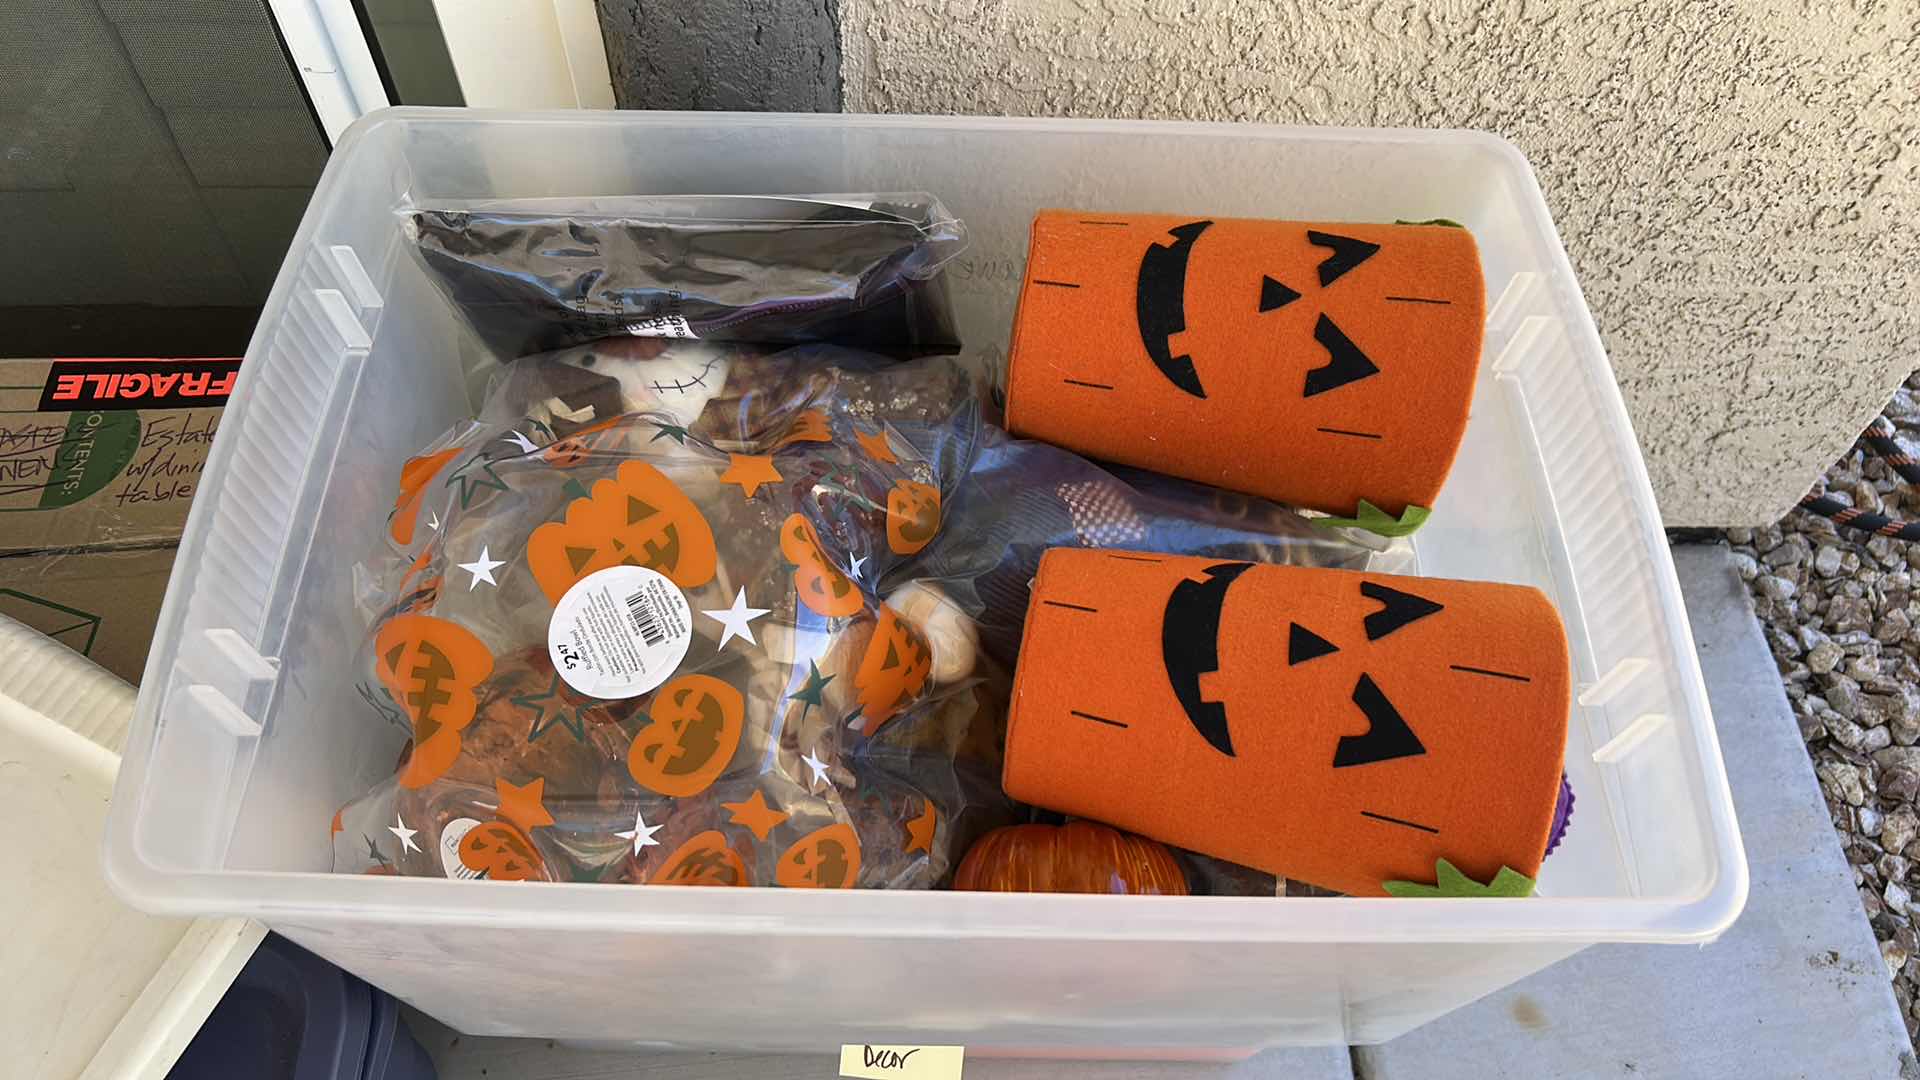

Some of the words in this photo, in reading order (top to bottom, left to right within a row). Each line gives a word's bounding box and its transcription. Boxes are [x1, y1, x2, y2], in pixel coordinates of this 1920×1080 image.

[53, 371, 239, 400] FRAGILE
[60, 410, 105, 496] ONTENTS:
[115, 481, 192, 507] table
[569, 628, 582, 646] Bowl
[576, 645, 594, 670] Ruffled
[864, 1045, 920, 1069] Decor
